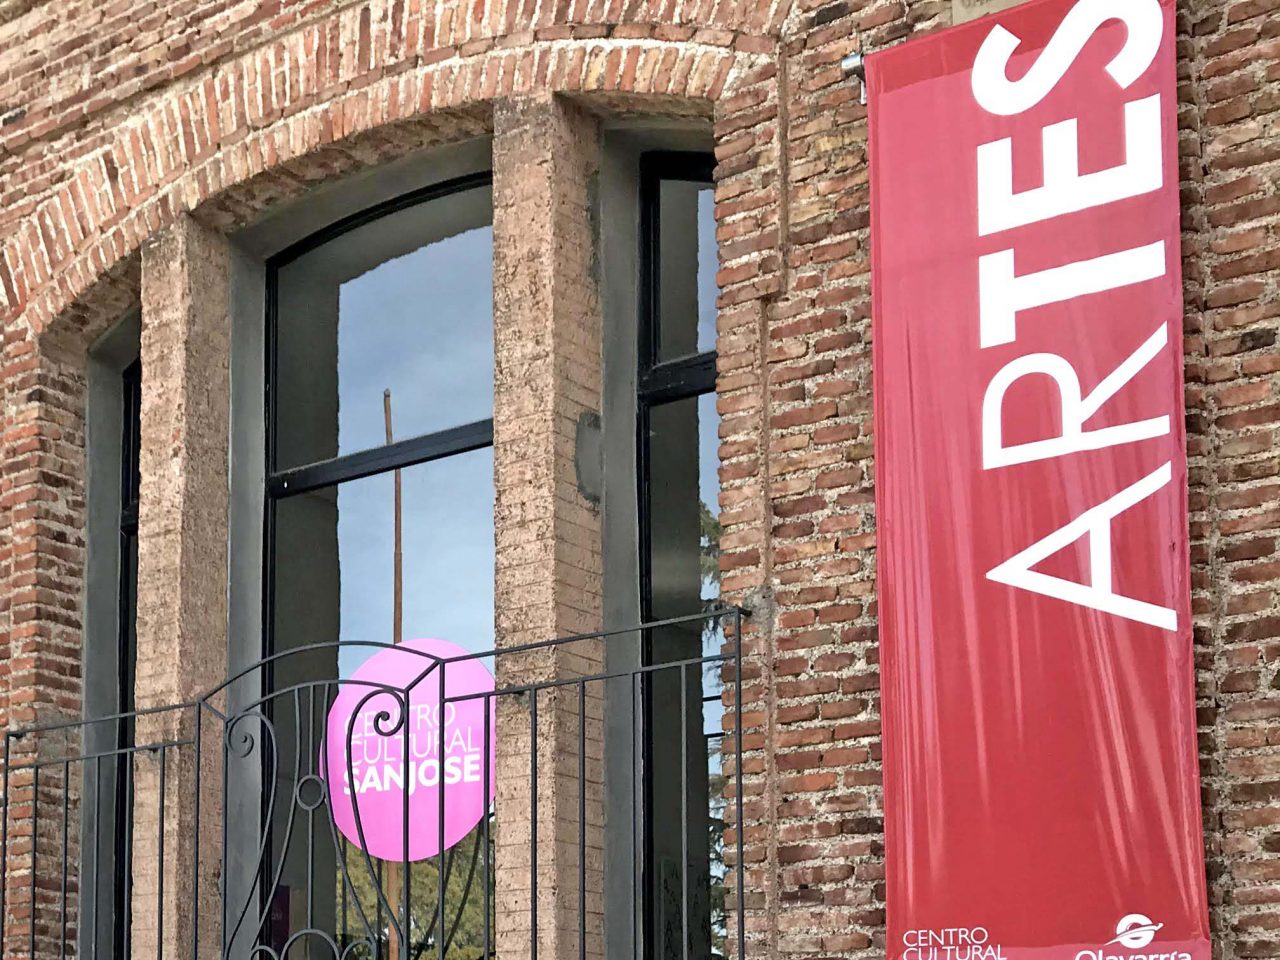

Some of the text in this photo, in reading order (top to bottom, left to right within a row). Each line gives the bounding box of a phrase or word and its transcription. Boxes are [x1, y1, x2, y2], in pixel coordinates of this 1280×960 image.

[971, 0, 1179, 633] ARTES
[343, 754, 481, 796] SANJOSE
[903, 927, 988, 947] CENTRO
